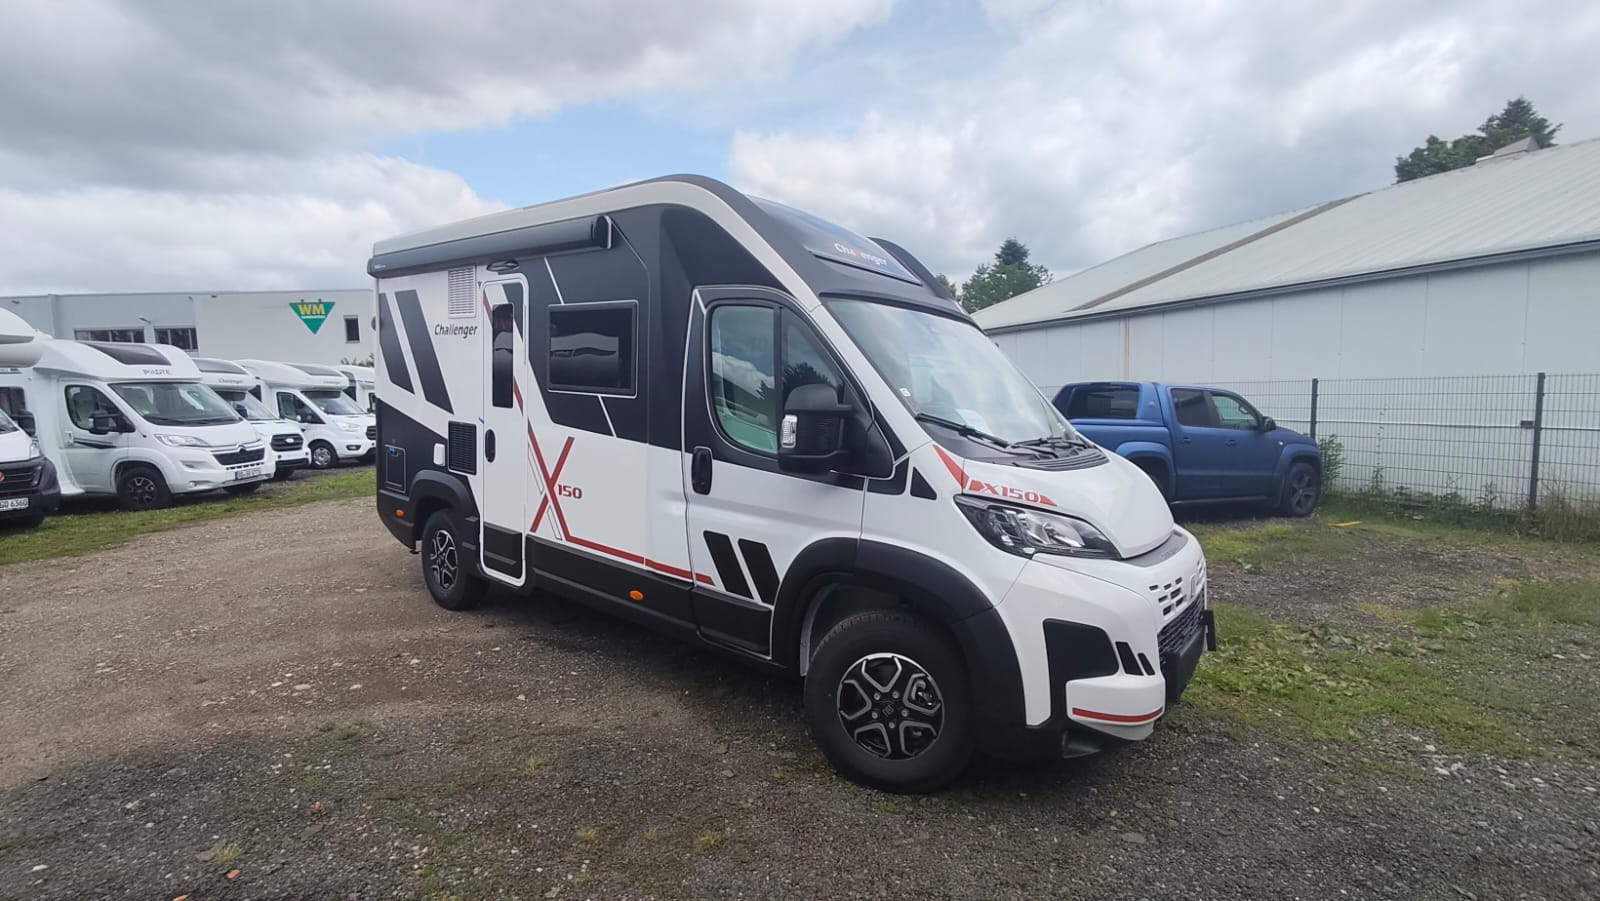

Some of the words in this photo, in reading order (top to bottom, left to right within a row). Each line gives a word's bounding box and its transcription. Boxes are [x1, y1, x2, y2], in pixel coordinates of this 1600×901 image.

[298, 303, 326, 315] WM
[434, 323, 478, 339] Challenger
[983, 482, 1040, 503] X150
